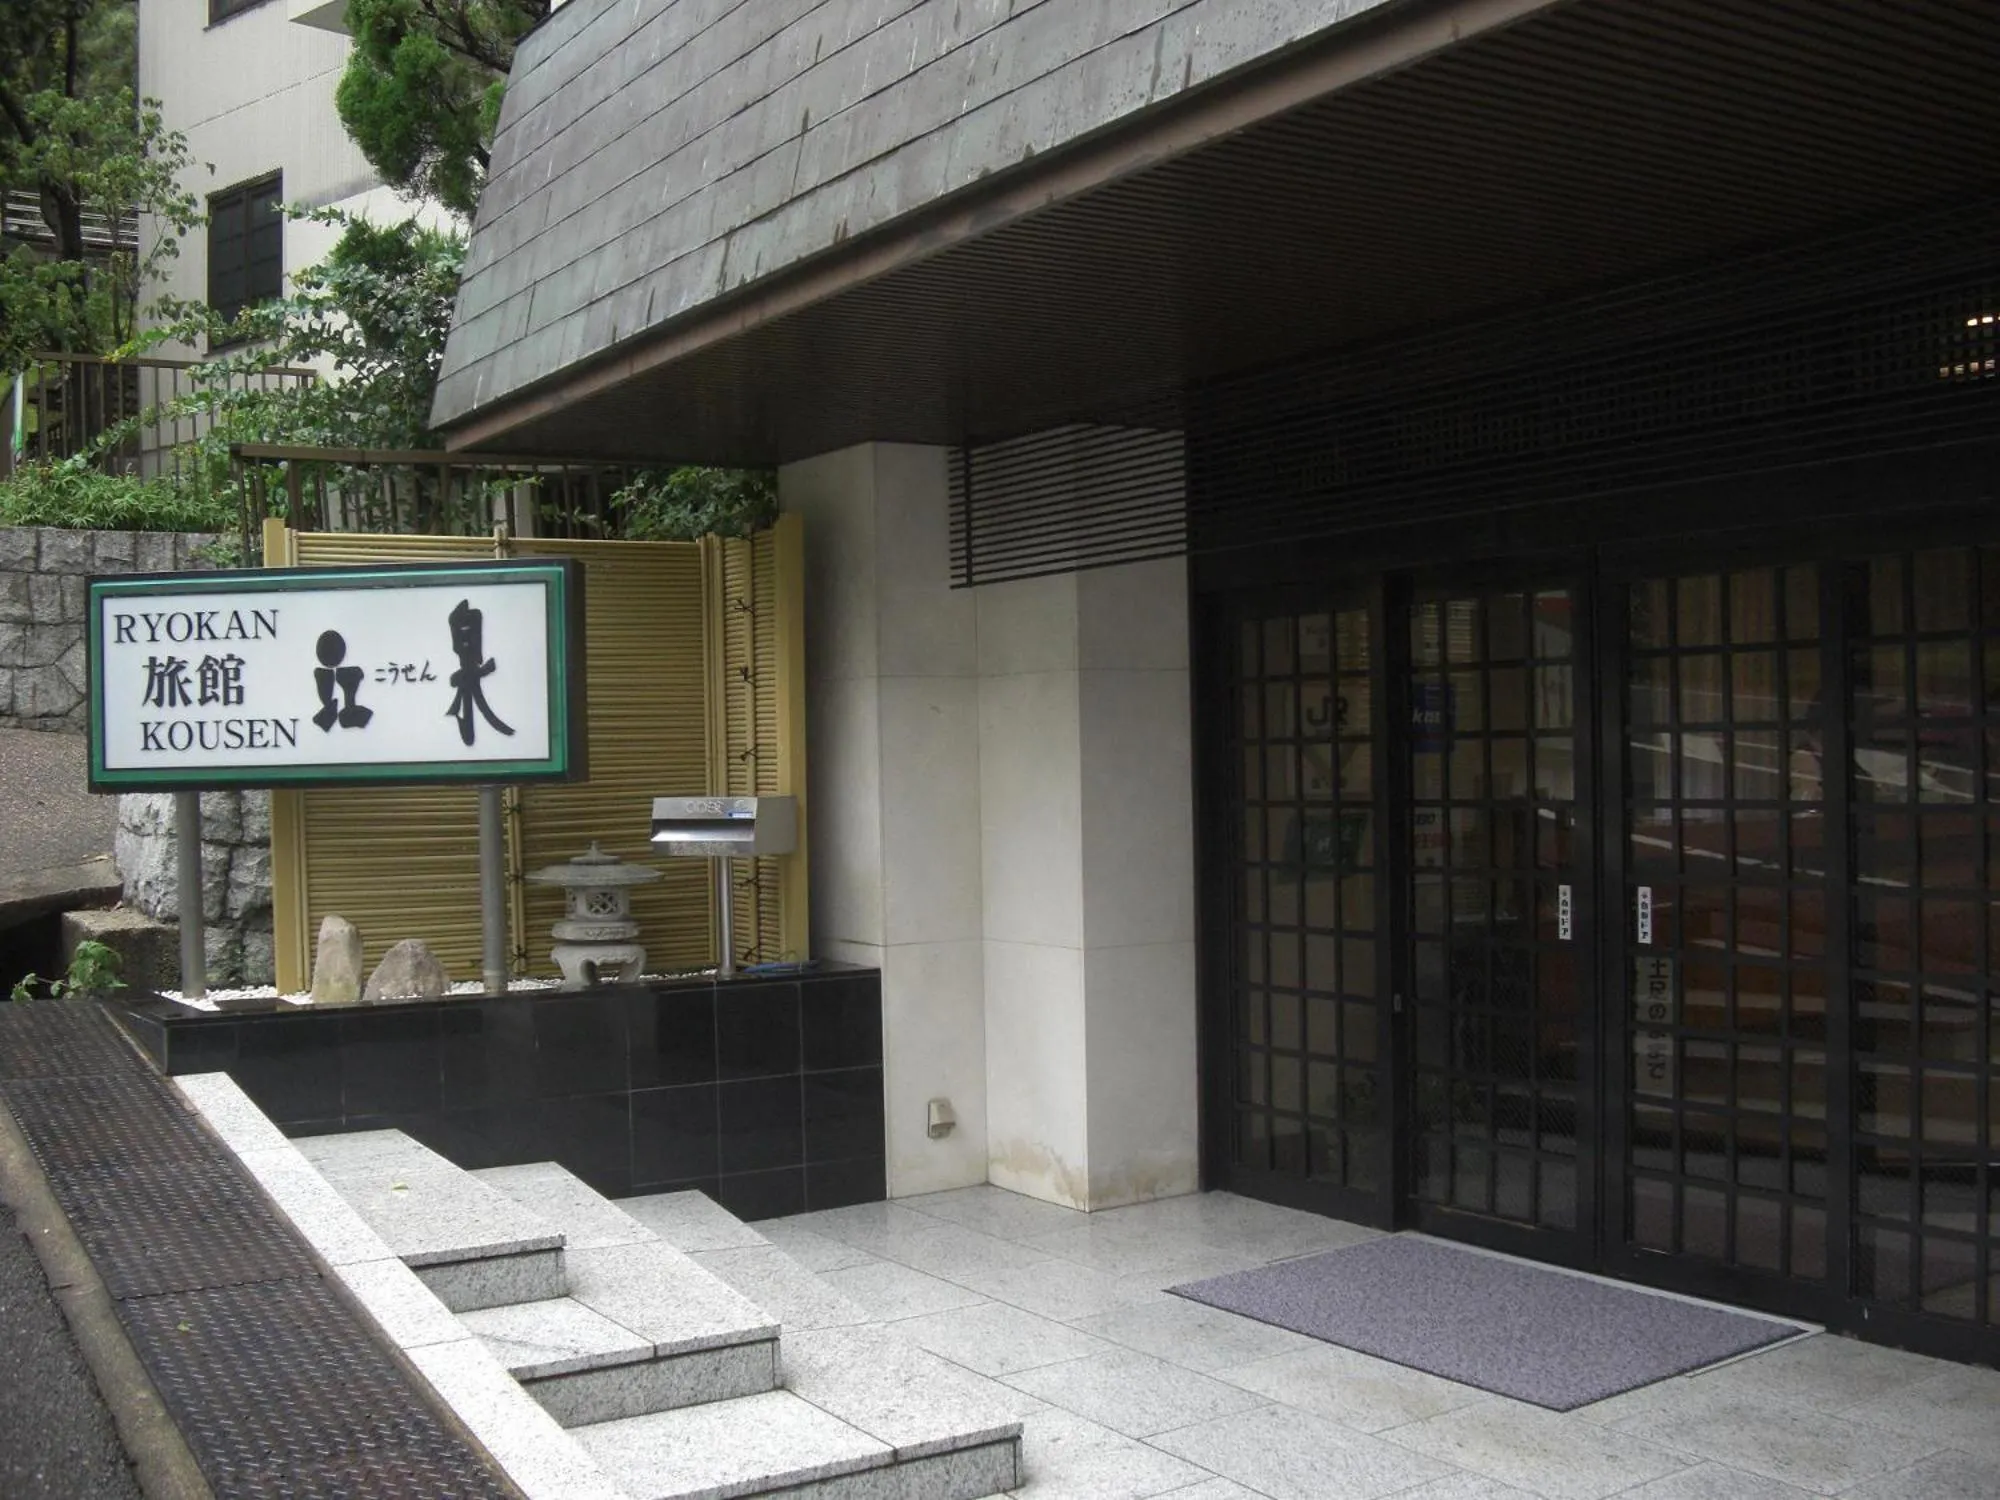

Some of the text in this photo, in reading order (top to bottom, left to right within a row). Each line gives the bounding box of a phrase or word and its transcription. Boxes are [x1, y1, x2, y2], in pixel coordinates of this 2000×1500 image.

[113, 609, 279, 644] RYOKAN
[141, 653, 247, 708] 旅館
[374, 660, 438, 685] こうせん
[443, 598, 517, 747] 泉
[140, 718, 300, 752] KOUSEN
